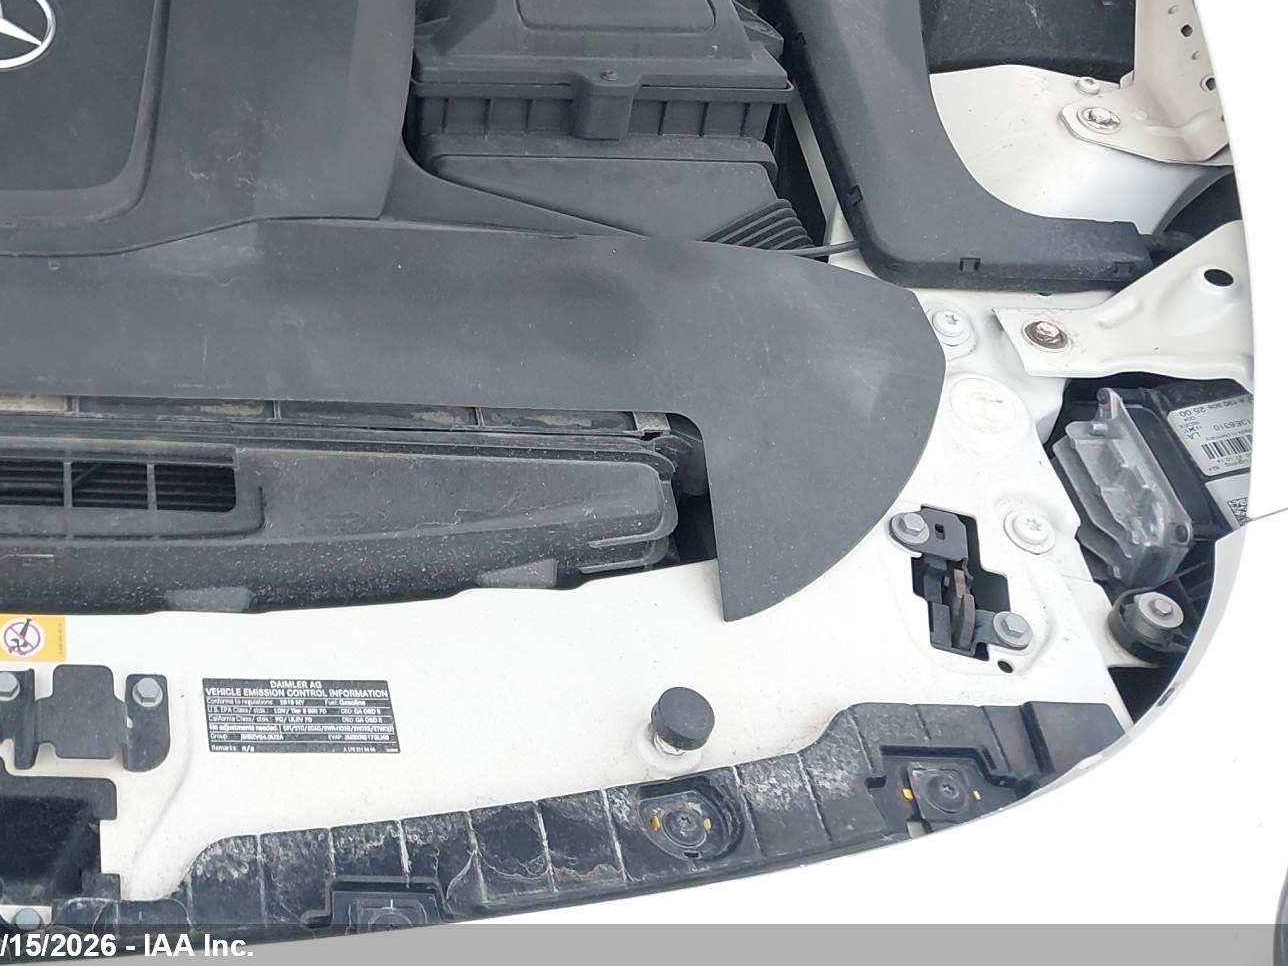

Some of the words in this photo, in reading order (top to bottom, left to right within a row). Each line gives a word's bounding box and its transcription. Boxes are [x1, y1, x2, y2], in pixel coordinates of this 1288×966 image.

[270, 680, 308, 689] DAIMLER
[310, 681, 322, 689] AG
[205, 688, 241, 697] VEHICLE
[243, 689, 285, 697] EMISSION
[287, 689, 328, 698] CONTROL
[330, 689, 388, 698] INFORMATION
